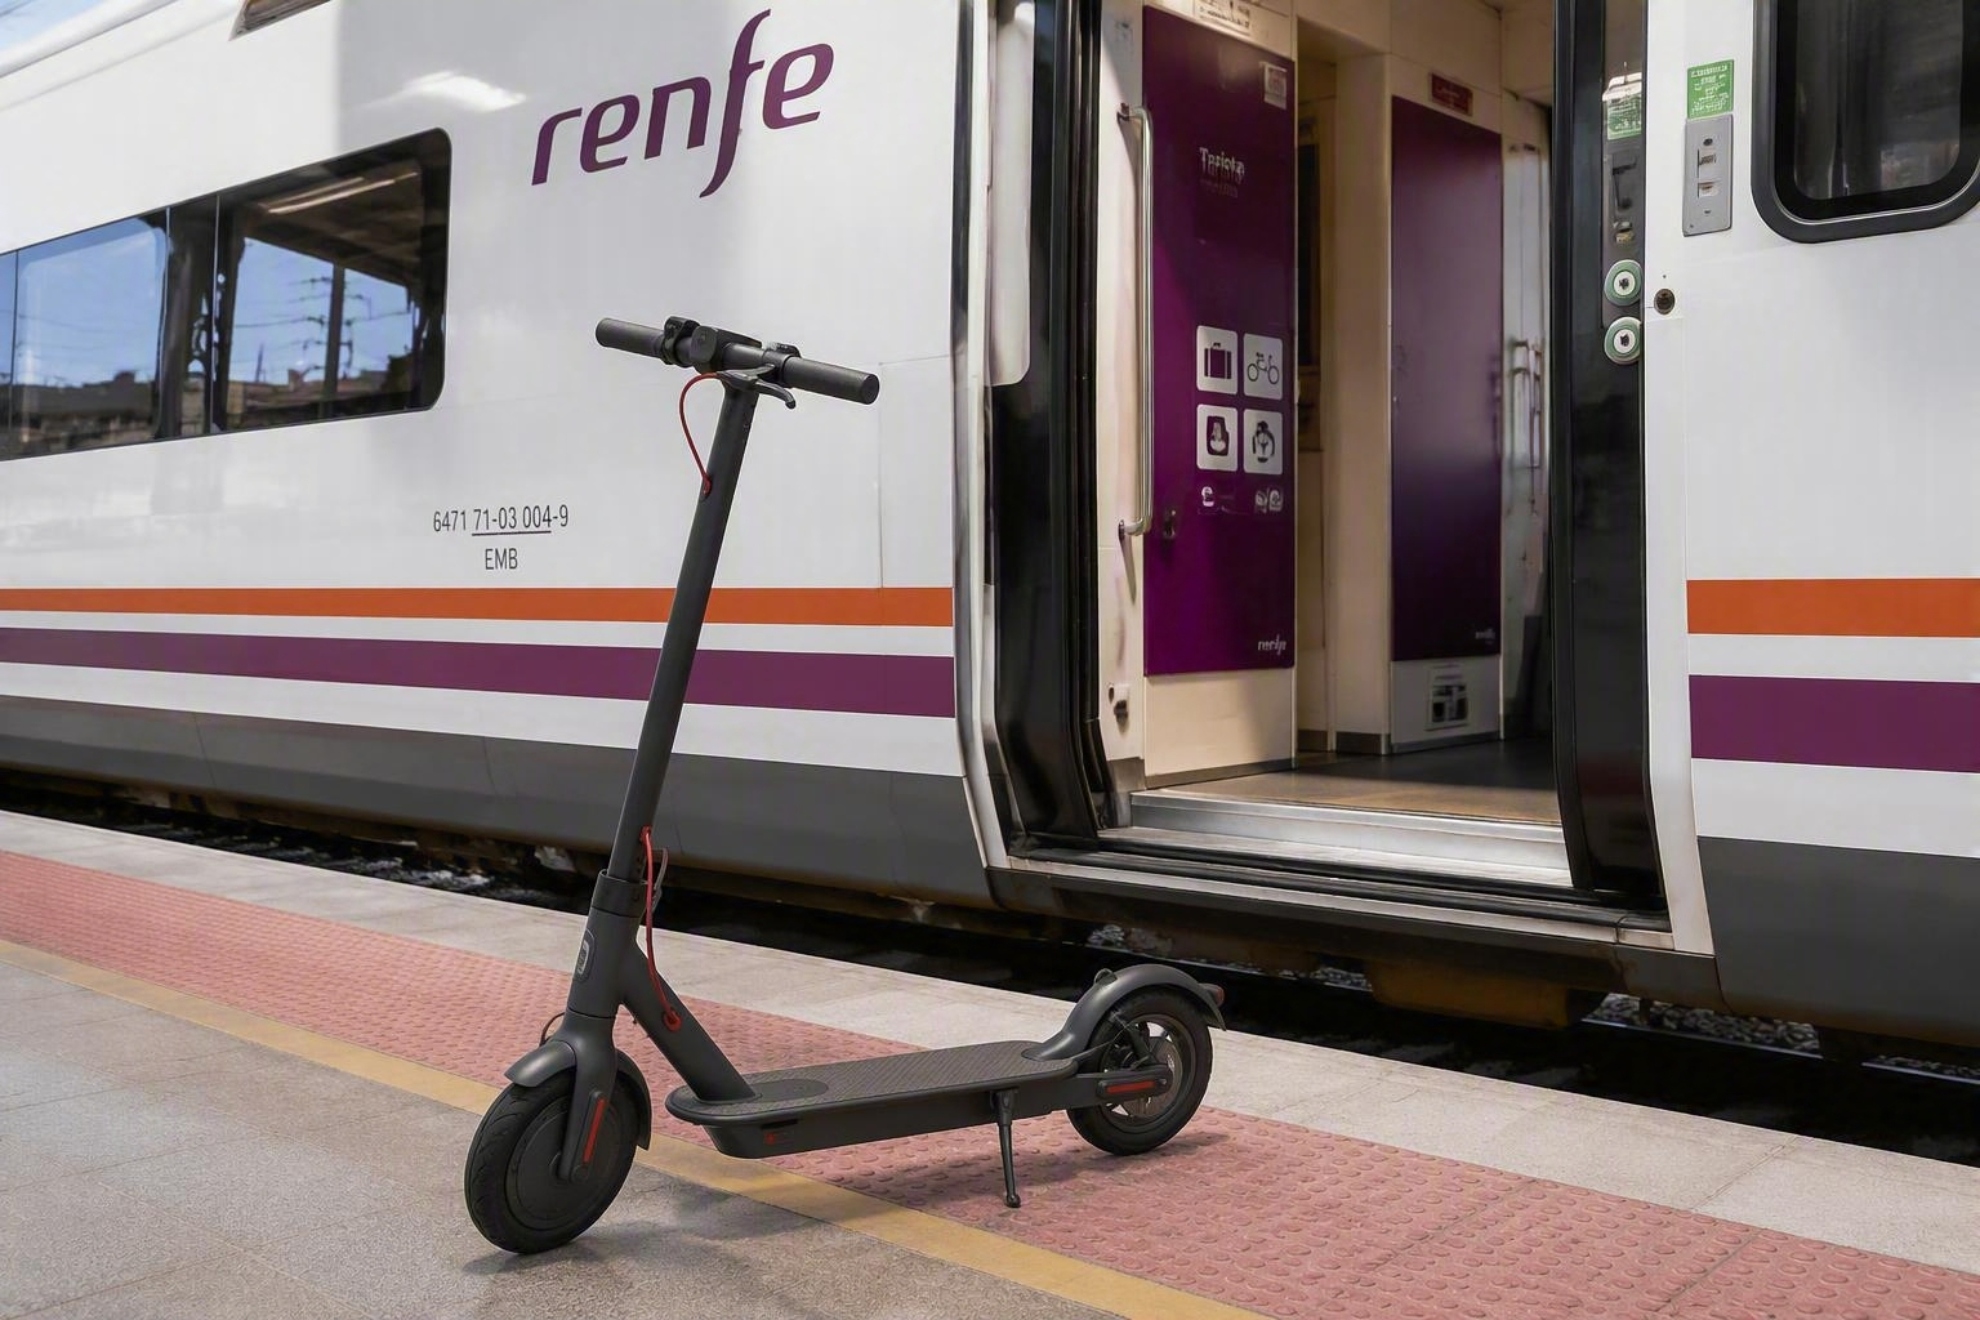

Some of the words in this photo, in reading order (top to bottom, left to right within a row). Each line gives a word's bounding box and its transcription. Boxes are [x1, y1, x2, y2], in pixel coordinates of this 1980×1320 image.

[531, 8, 834, 199] renfe
[433, 510, 467, 532] 6471
[473, 507, 518, 531] 71-03
[522, 504, 569, 529] 004-9
[485, 547, 518, 570] EMB
